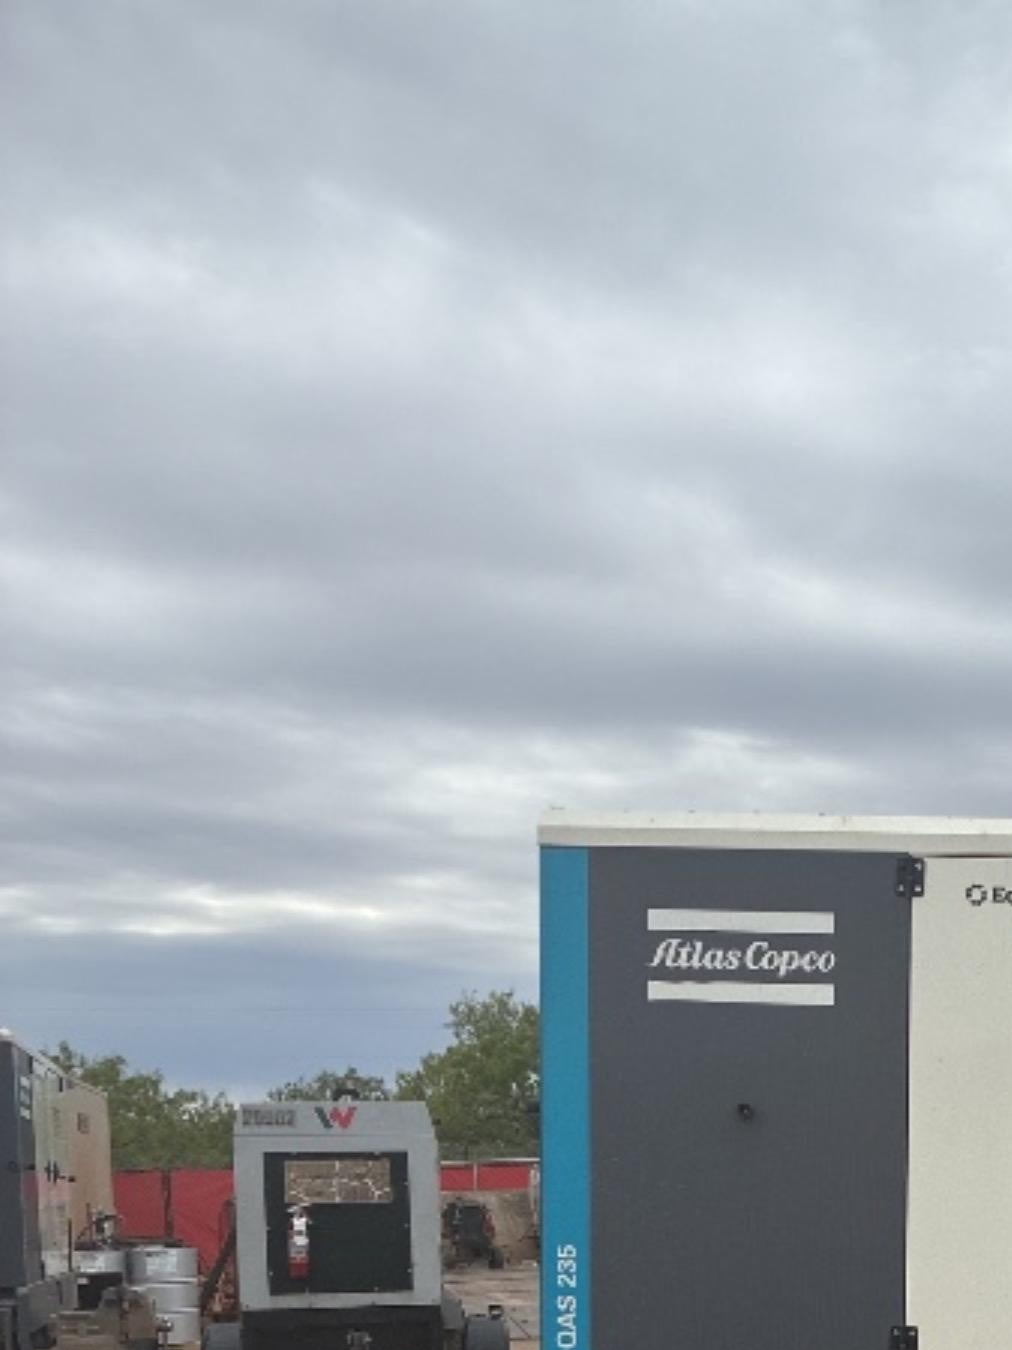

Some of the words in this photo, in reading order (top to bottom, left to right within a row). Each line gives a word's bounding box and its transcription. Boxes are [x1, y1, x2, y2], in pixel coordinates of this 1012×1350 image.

[648, 938, 742, 970] Atlas
[746, 941, 836, 979] Copco
[557, 1244, 577, 1288] 235
[557, 1295, 577, 1350] QAS
